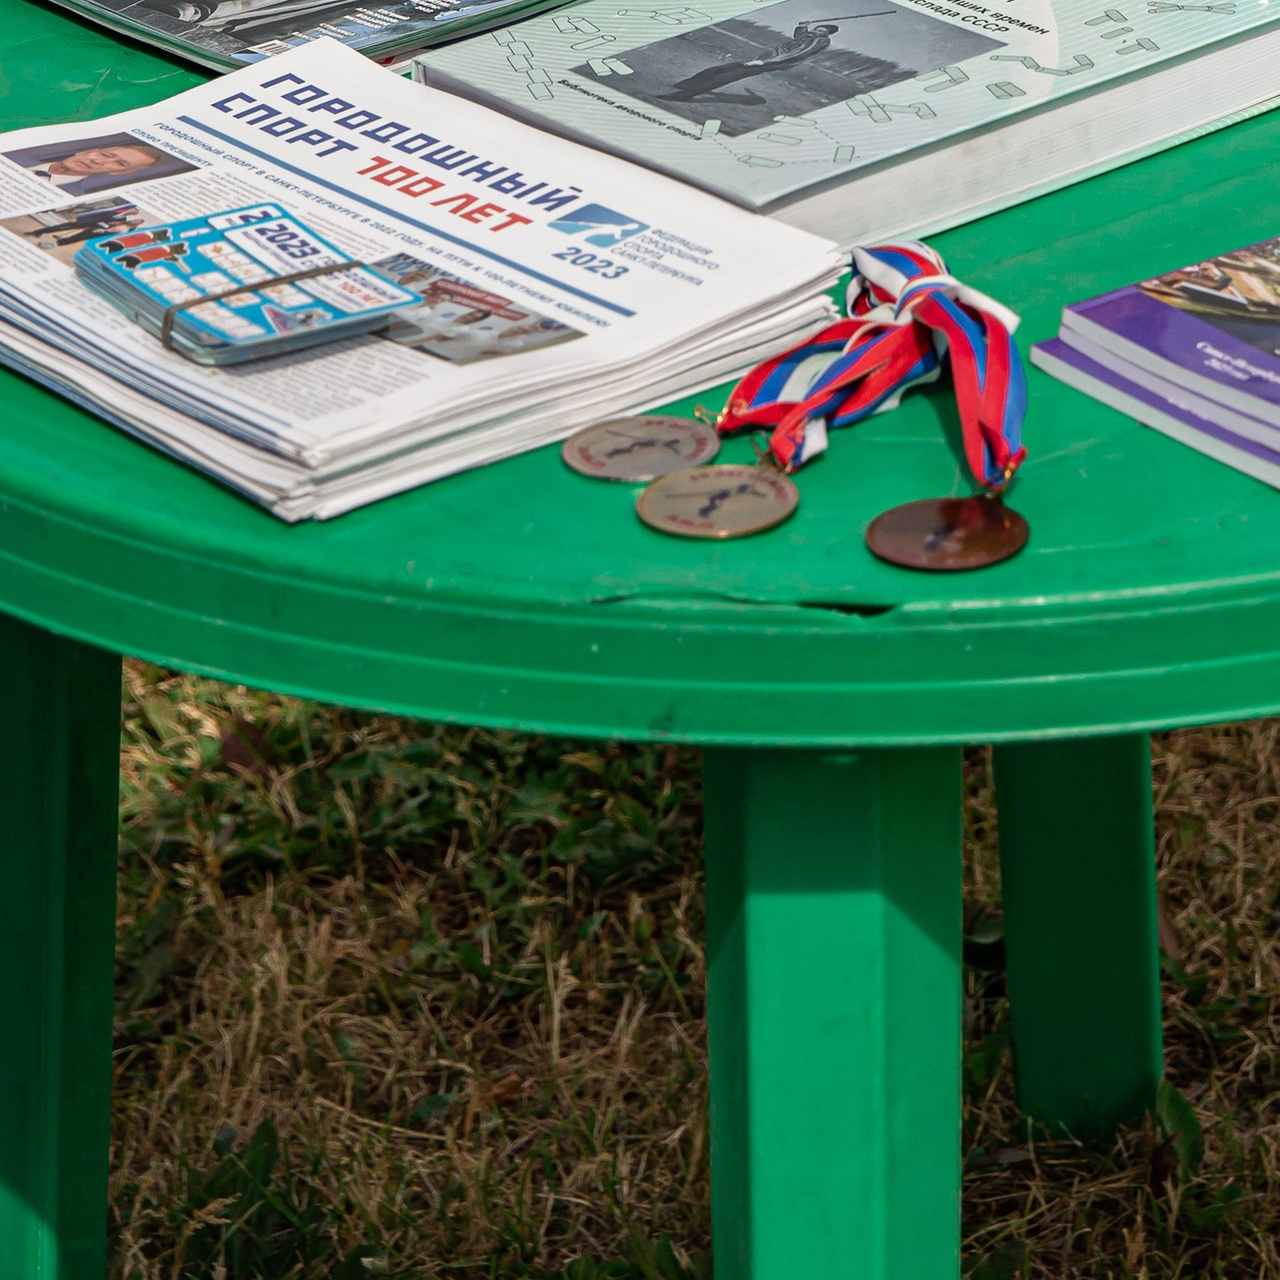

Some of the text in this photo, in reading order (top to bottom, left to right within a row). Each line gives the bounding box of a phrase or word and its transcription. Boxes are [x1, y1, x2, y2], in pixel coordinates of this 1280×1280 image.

[961, 15, 1010, 34] СССР
[990, 11, 1050, 36] времен
[557, 79, 616, 106] Библиотека
[666, 125, 703, 141] спорта
[131, 128, 215, 168] СЛОВО ПРЕЗИДЕНТУ
[210, 92, 534, 233] СПОРТ 100 ЛЕТ
[259, 72, 583, 213] ГОРОДОШНЫЙ
[153, 122, 223, 158] ГОРОДОШНЫЙ
[223, 152, 257, 173] СПОРТ
[254, 168, 264, 176] В
[264, 174, 360, 220] САНКТ-ПЕТЕРБУРГЕ
[368, 220, 395, 236] 2022
[426, 245, 445, 258] НА
[443, 252, 472, 269] ПУТИ
[472, 264, 483, 272] К
[483, 269, 556, 305] 100-ЛЕТНЕМУ
[254, 223, 321, 259] 2023
[623, 241, 665, 260] СПОРТА
[636, 234, 720, 270] ГОРОДОШНОГО
[319, 256, 402, 301] ГООДОШНЫЙ
[551, 246, 630, 279] 2023
[610, 246, 705, 287] САНКТ-ПЕТЕРБУРГА
